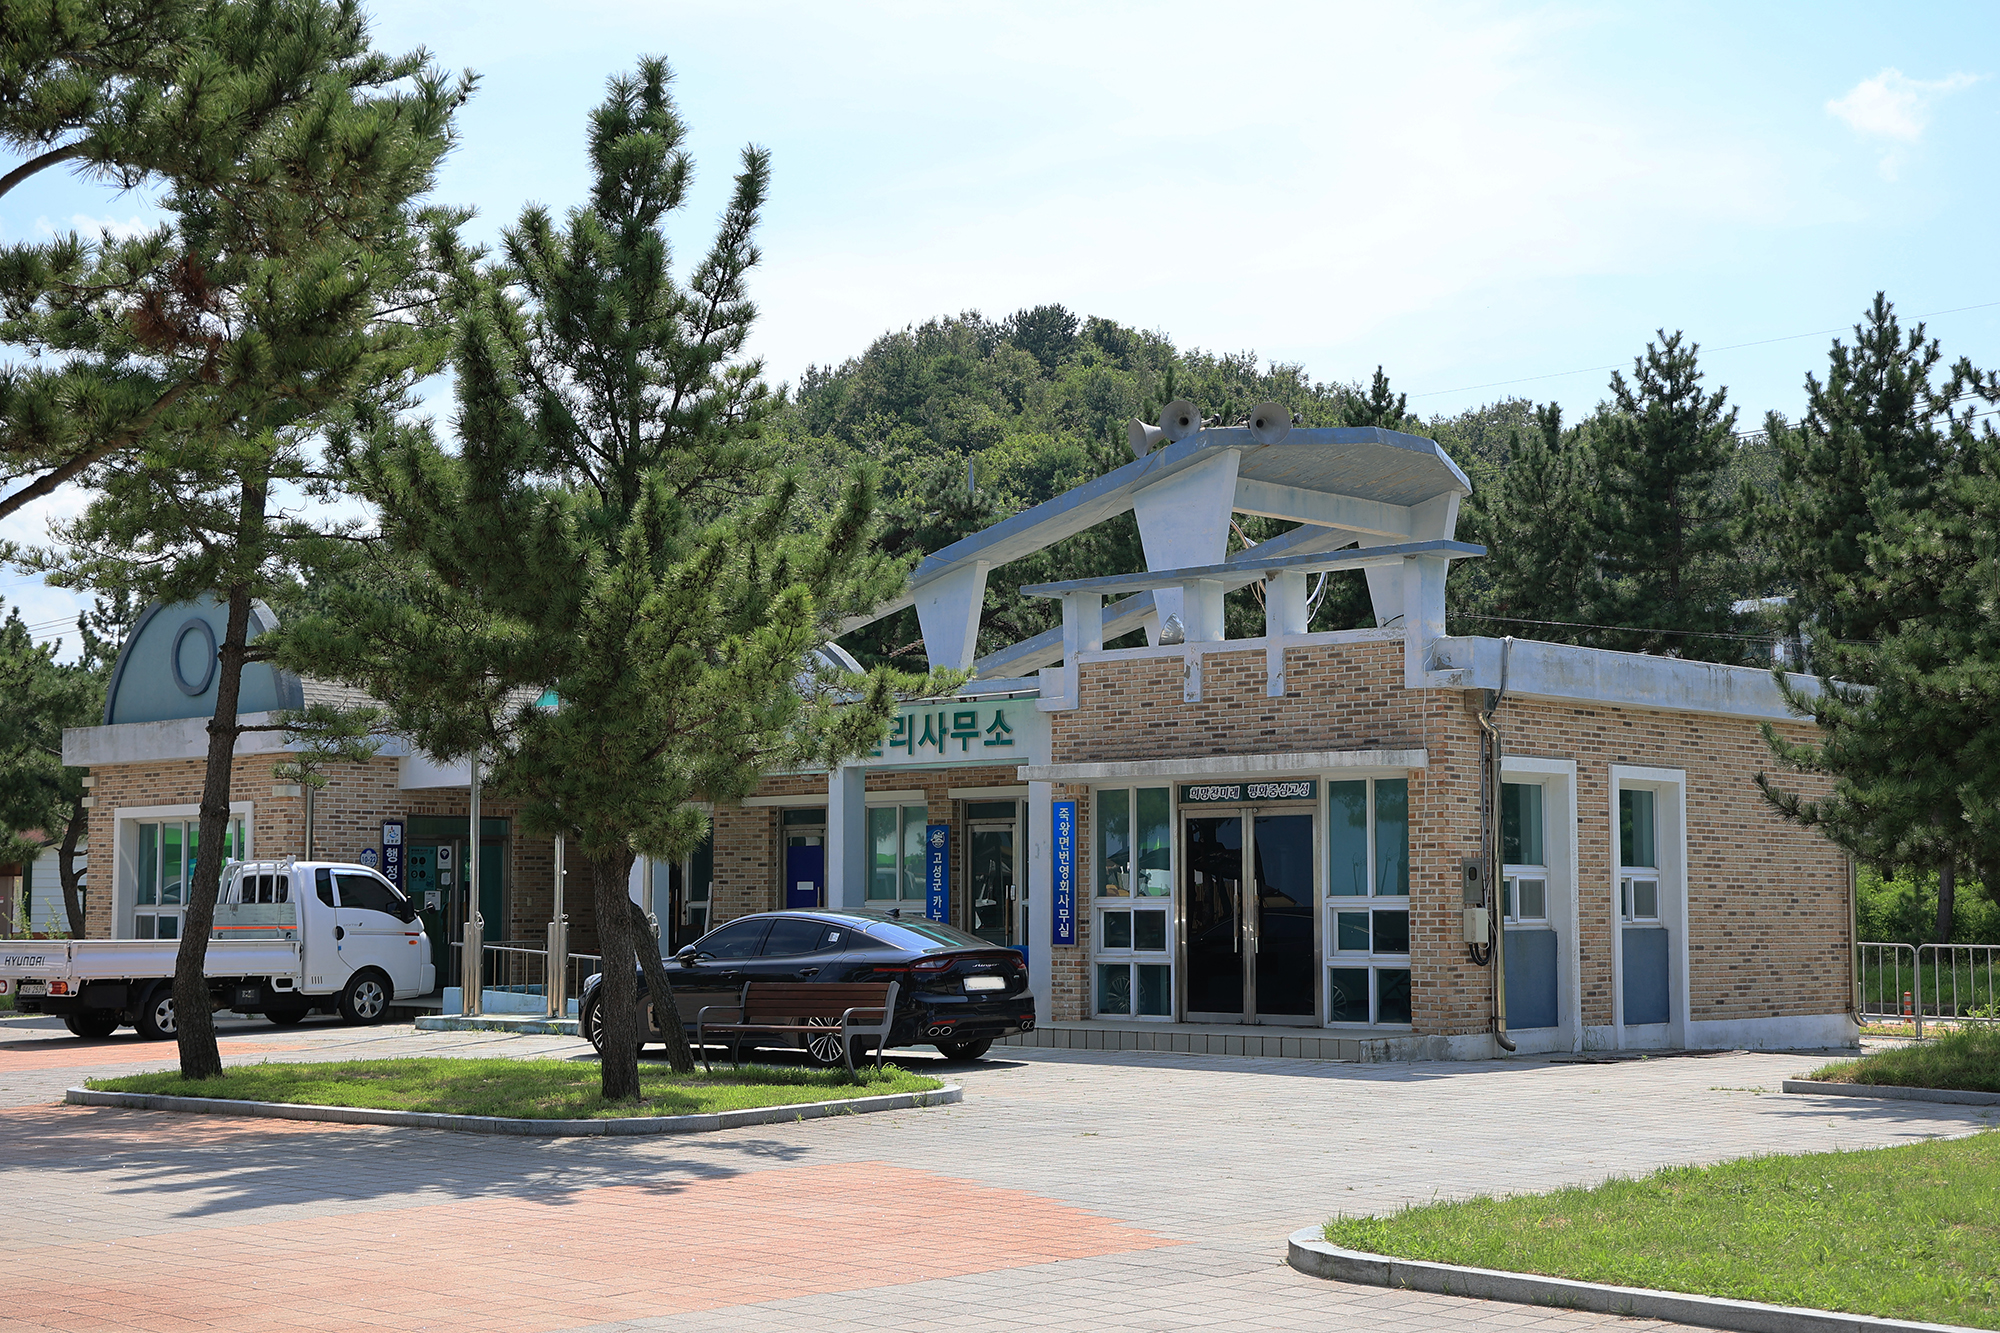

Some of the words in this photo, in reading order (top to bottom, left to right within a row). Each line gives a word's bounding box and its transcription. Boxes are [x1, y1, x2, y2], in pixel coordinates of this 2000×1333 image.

[871, 709, 1014, 757] 리사무소
[386, 848, 398, 888] 행정
[932, 852, 943, 892] 고성군
[1058, 807, 1071, 938] 죽왕면번영회사무실
[5, 956, 45, 966] HYUNDAI
